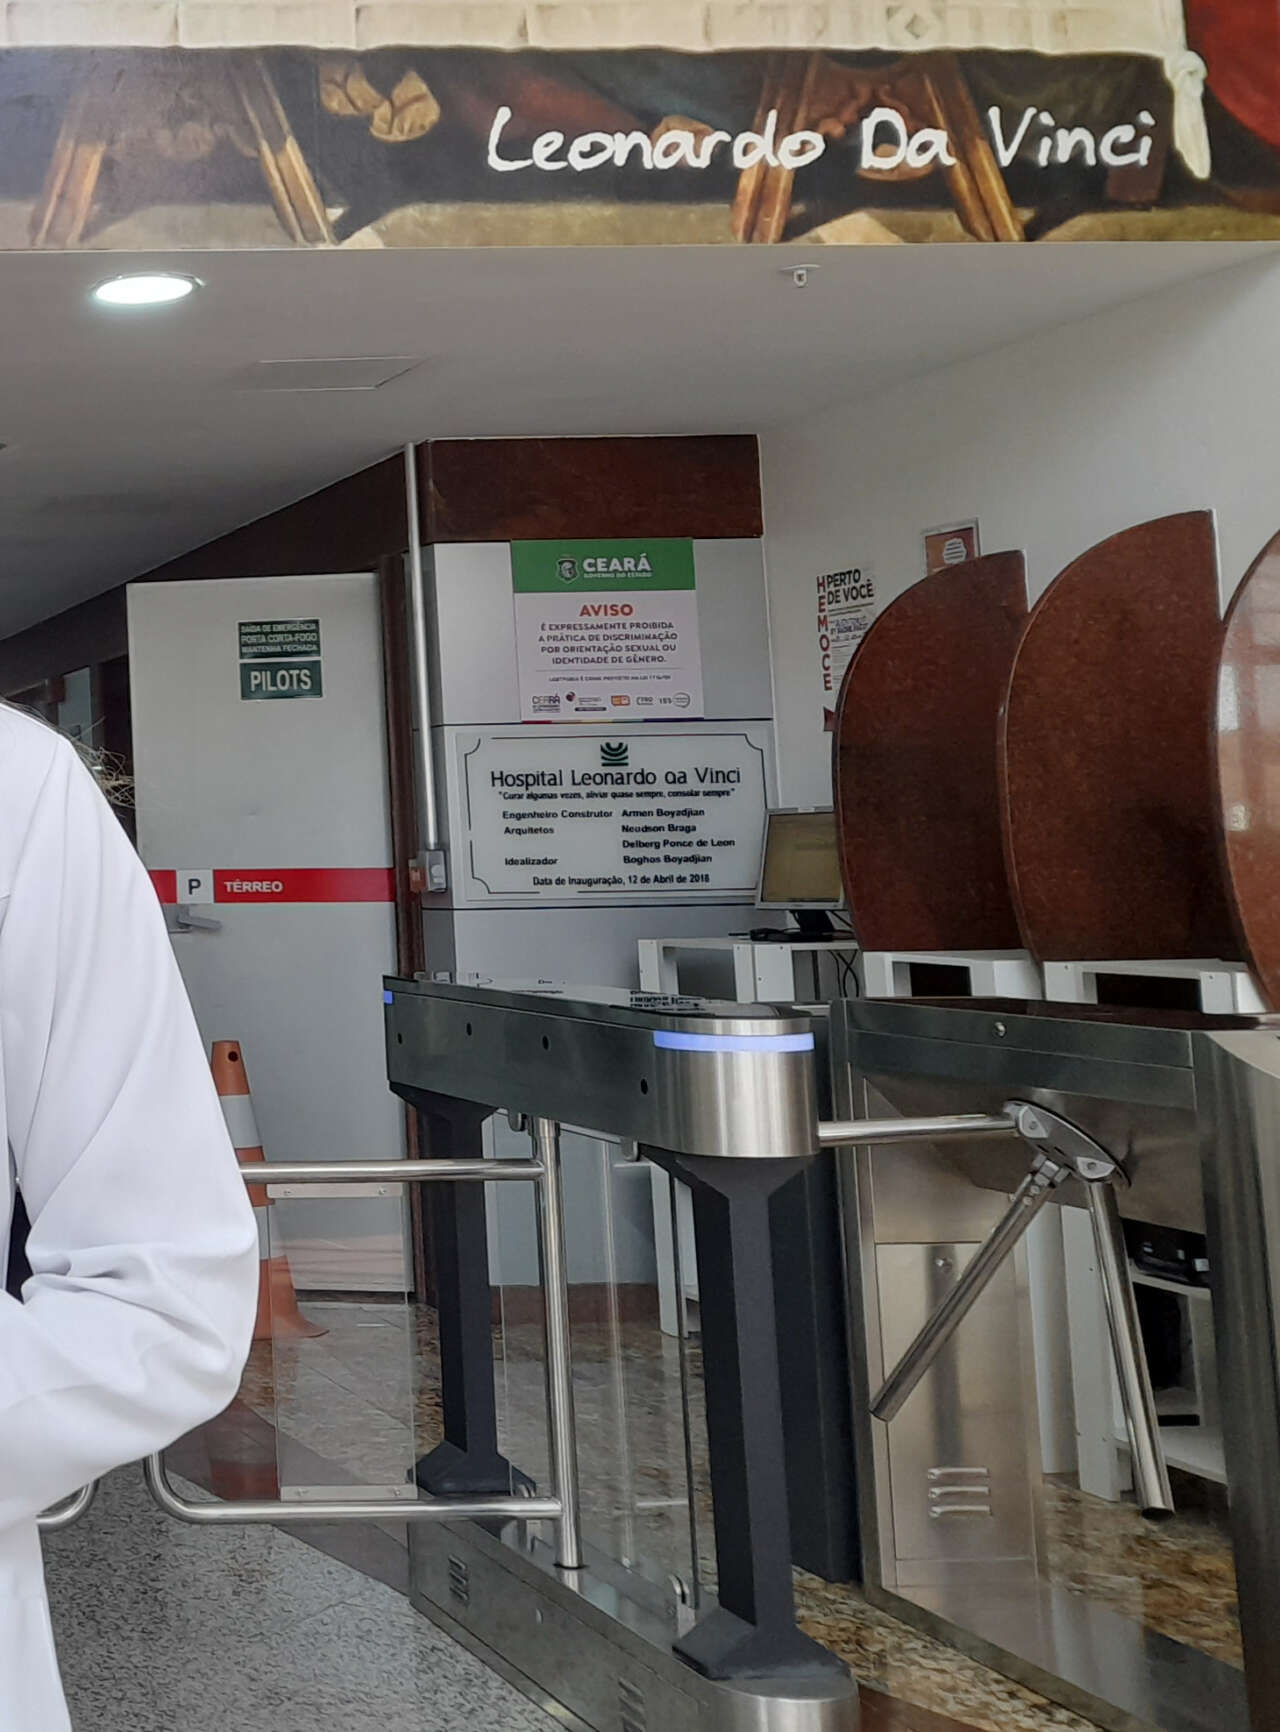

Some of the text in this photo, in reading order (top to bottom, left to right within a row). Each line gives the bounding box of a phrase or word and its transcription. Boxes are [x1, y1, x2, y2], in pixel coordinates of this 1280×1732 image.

[487, 106, 1156, 171] Leonardo Da Vinci
[583, 553, 652, 572] CEARÁ
[827, 568, 861, 588] PERTO
[827, 579, 874, 605] DE VOCÊ
[579, 604, 634, 617] AVISO
[541, 622, 674, 631] É EXPRESSAMENTE PROIBIDA
[546, 632, 586, 642] PRÁTICA
[603, 631, 678, 642] DISCRIMINAÇÃO
[563, 643, 623, 654] ORIENTAÇÃO
[625, 644, 660, 652] SEXUAL
[626, 654, 666, 663] GÊNERO.
[250, 669, 312, 692] PILOTS
[490, 769, 563, 791] Hospital
[571, 768, 658, 787] Leonardo
[694, 767, 741, 784] Vinci
[502, 808, 705, 820] Engenheiro Construtor Armen Boyadjian
[504, 826, 554, 836] Arquitetos
[667, 824, 697, 834] Braga
[622, 838, 736, 849] Delberg Ponce de Leon
[505, 854, 712, 866] Idealizador Boghos Boyadjian
[533, 876, 553, 886] Data
[555, 876, 566, 885] de
[628, 875, 638, 884] 12
[640, 875, 650, 884] de
[653, 874, 674, 884] Abril
[676, 874, 687, 883] de
[689, 874, 710, 883] 2018
[188, 878, 283, 895] P TÉRREO
